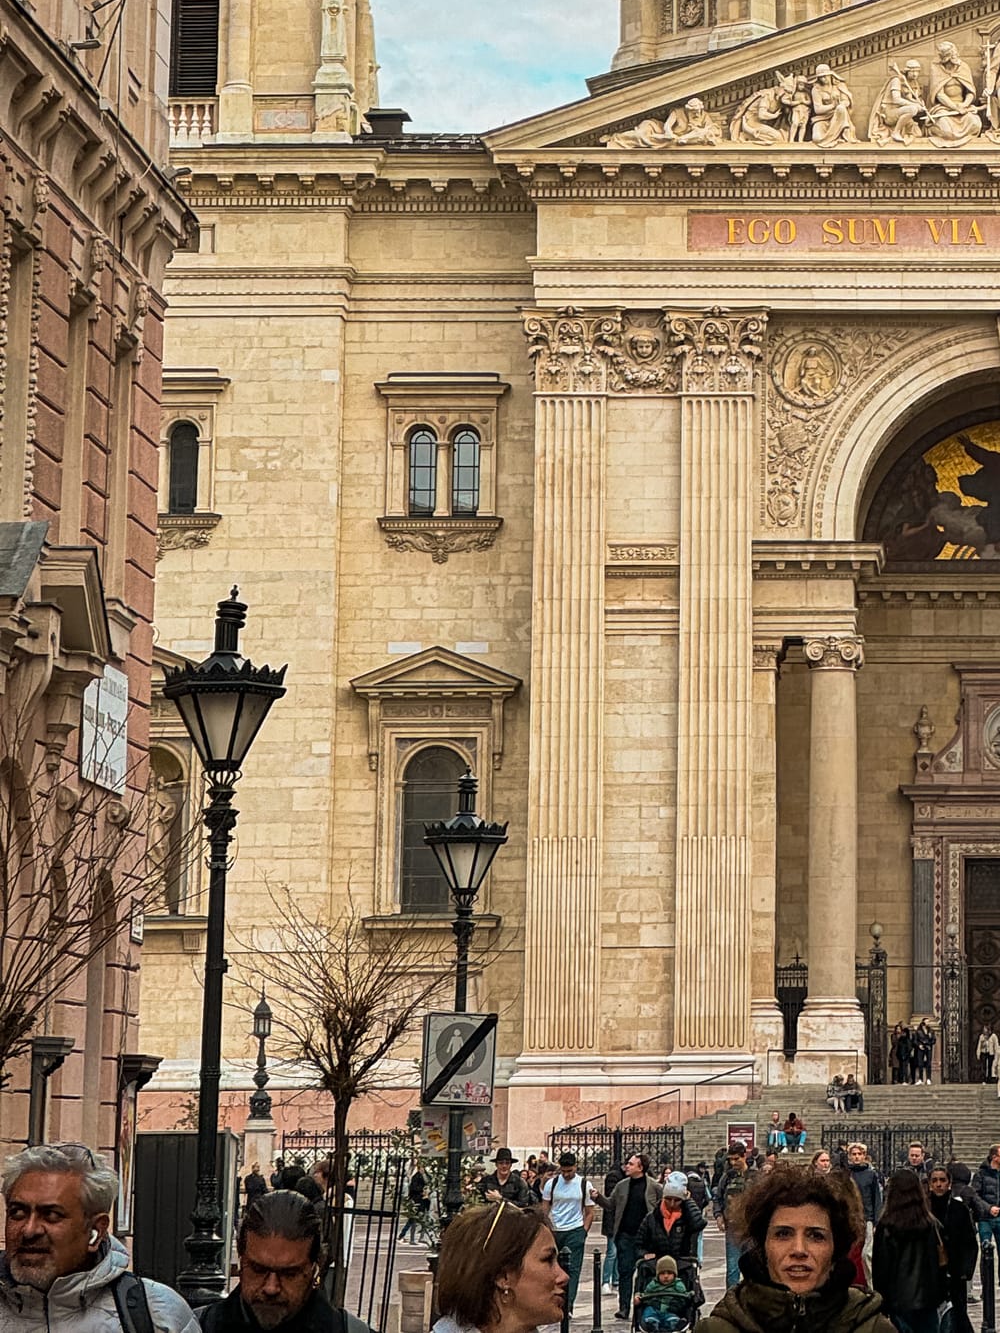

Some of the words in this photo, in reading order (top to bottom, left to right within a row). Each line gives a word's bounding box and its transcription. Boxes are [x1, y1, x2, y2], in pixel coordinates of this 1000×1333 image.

[725, 217, 797, 245] EGO
[821, 217, 899, 245] SUM
[925, 217, 987, 245] VIA
